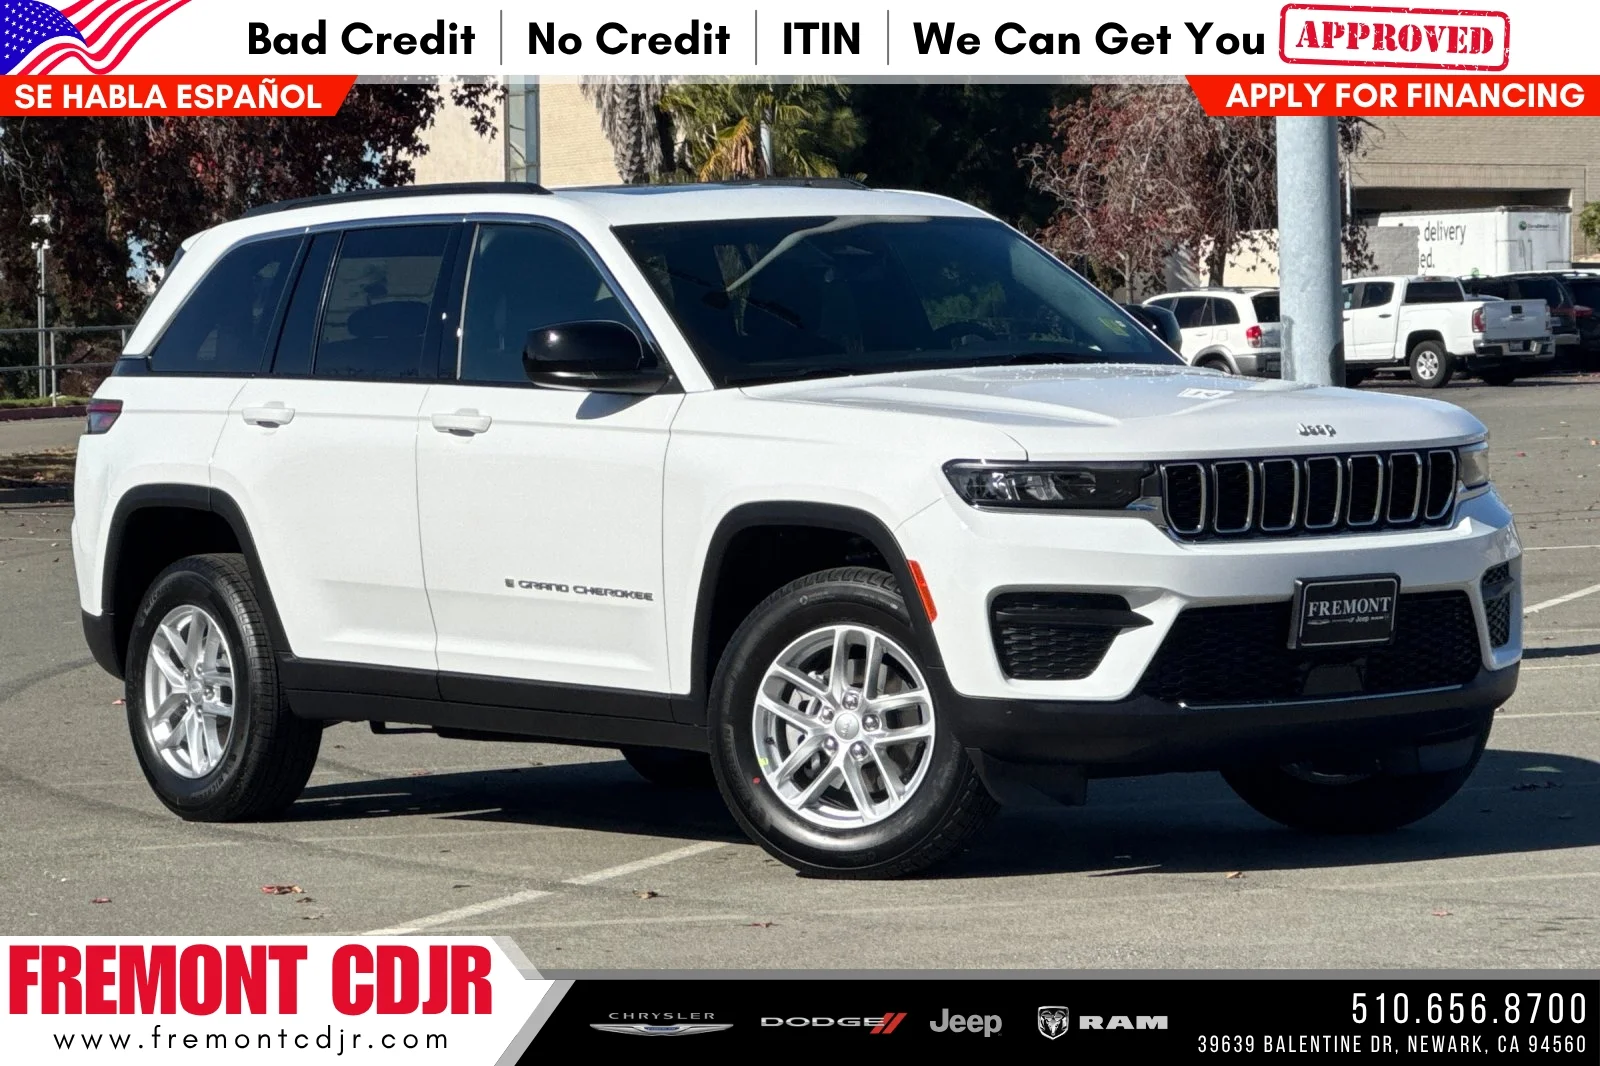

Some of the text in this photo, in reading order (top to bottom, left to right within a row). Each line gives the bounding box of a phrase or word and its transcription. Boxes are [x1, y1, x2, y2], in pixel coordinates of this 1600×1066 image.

[1424, 220, 1466, 245] delivery
[518, 580, 654, 602] GRAND CHEROKEE
[1307, 596, 1392, 617] FREMONT
